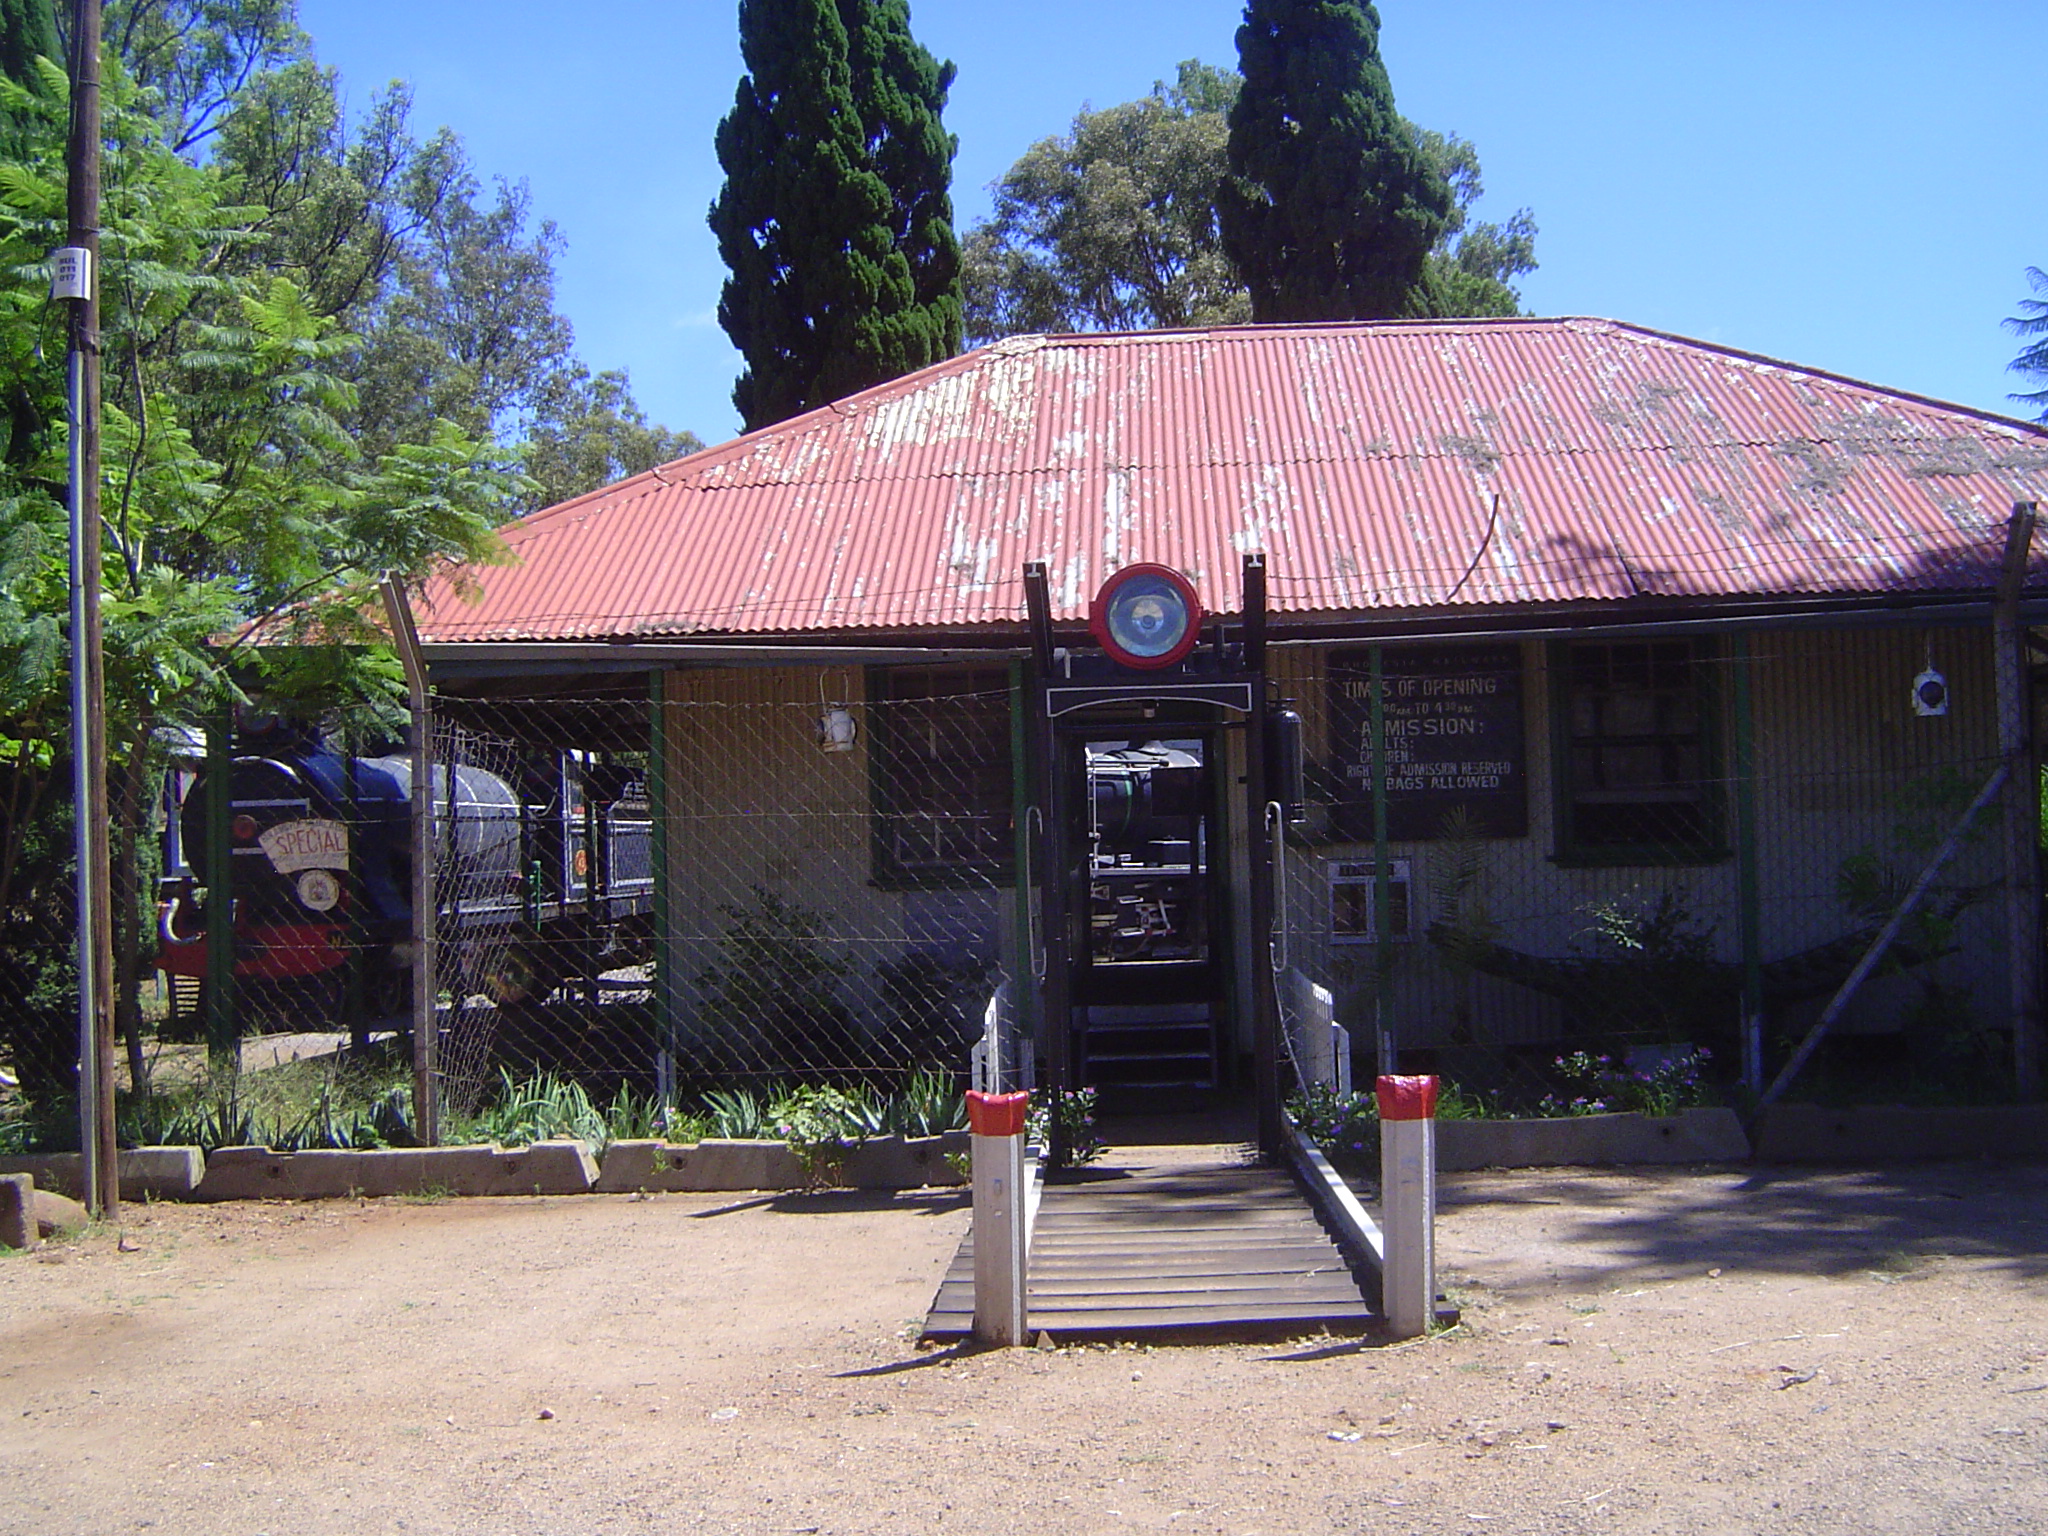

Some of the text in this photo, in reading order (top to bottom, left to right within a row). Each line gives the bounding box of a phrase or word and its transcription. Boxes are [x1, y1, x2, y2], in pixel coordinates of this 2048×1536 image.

[1343, 678, 1497, 698] TIMS OF OPENING
[1415, 702, 1429, 714] TO
[1361, 719, 1484, 737] AMISSION:
[1361, 737, 1414, 750] ALTS:
[1400, 762, 1457, 776] ADMISSION
[1461, 761, 1511, 775] RESERVED
[1386, 777, 1424, 791] BAGS
[1430, 775, 1500, 789] ALLOWED
[276, 828, 345, 854] SPECIAL
